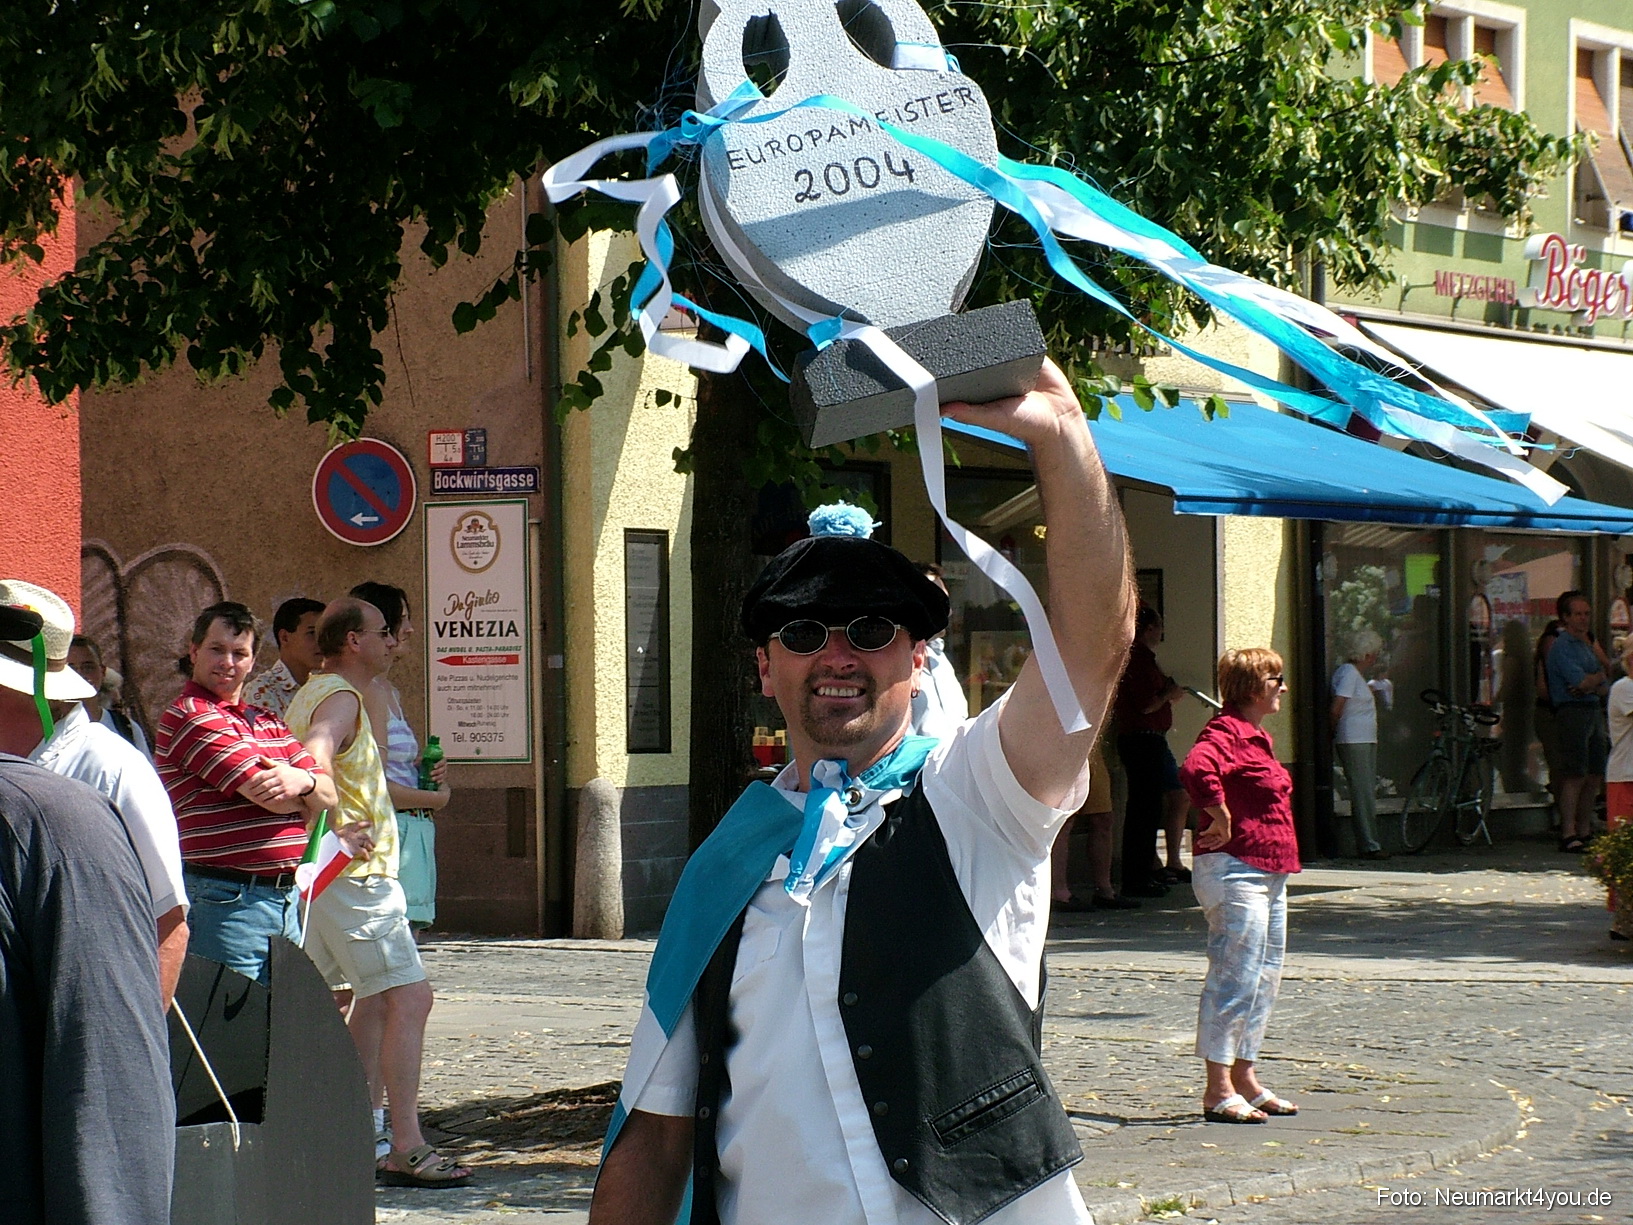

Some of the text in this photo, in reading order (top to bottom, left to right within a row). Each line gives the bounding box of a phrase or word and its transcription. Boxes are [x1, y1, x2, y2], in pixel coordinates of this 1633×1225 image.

[727, 86, 977, 170] EUROPAMEISTER
[794, 151, 915, 203] 2004
[1435, 270, 1516, 305] METZGEREI
[1527, 232, 1633, 326] Böger
[434, 471, 534, 491] Bockwirtsgasse
[456, 541, 495, 549] Lammsbräu
[434, 620, 519, 638] VENEZIA
[451, 732, 504, 743] Tel. 905375
